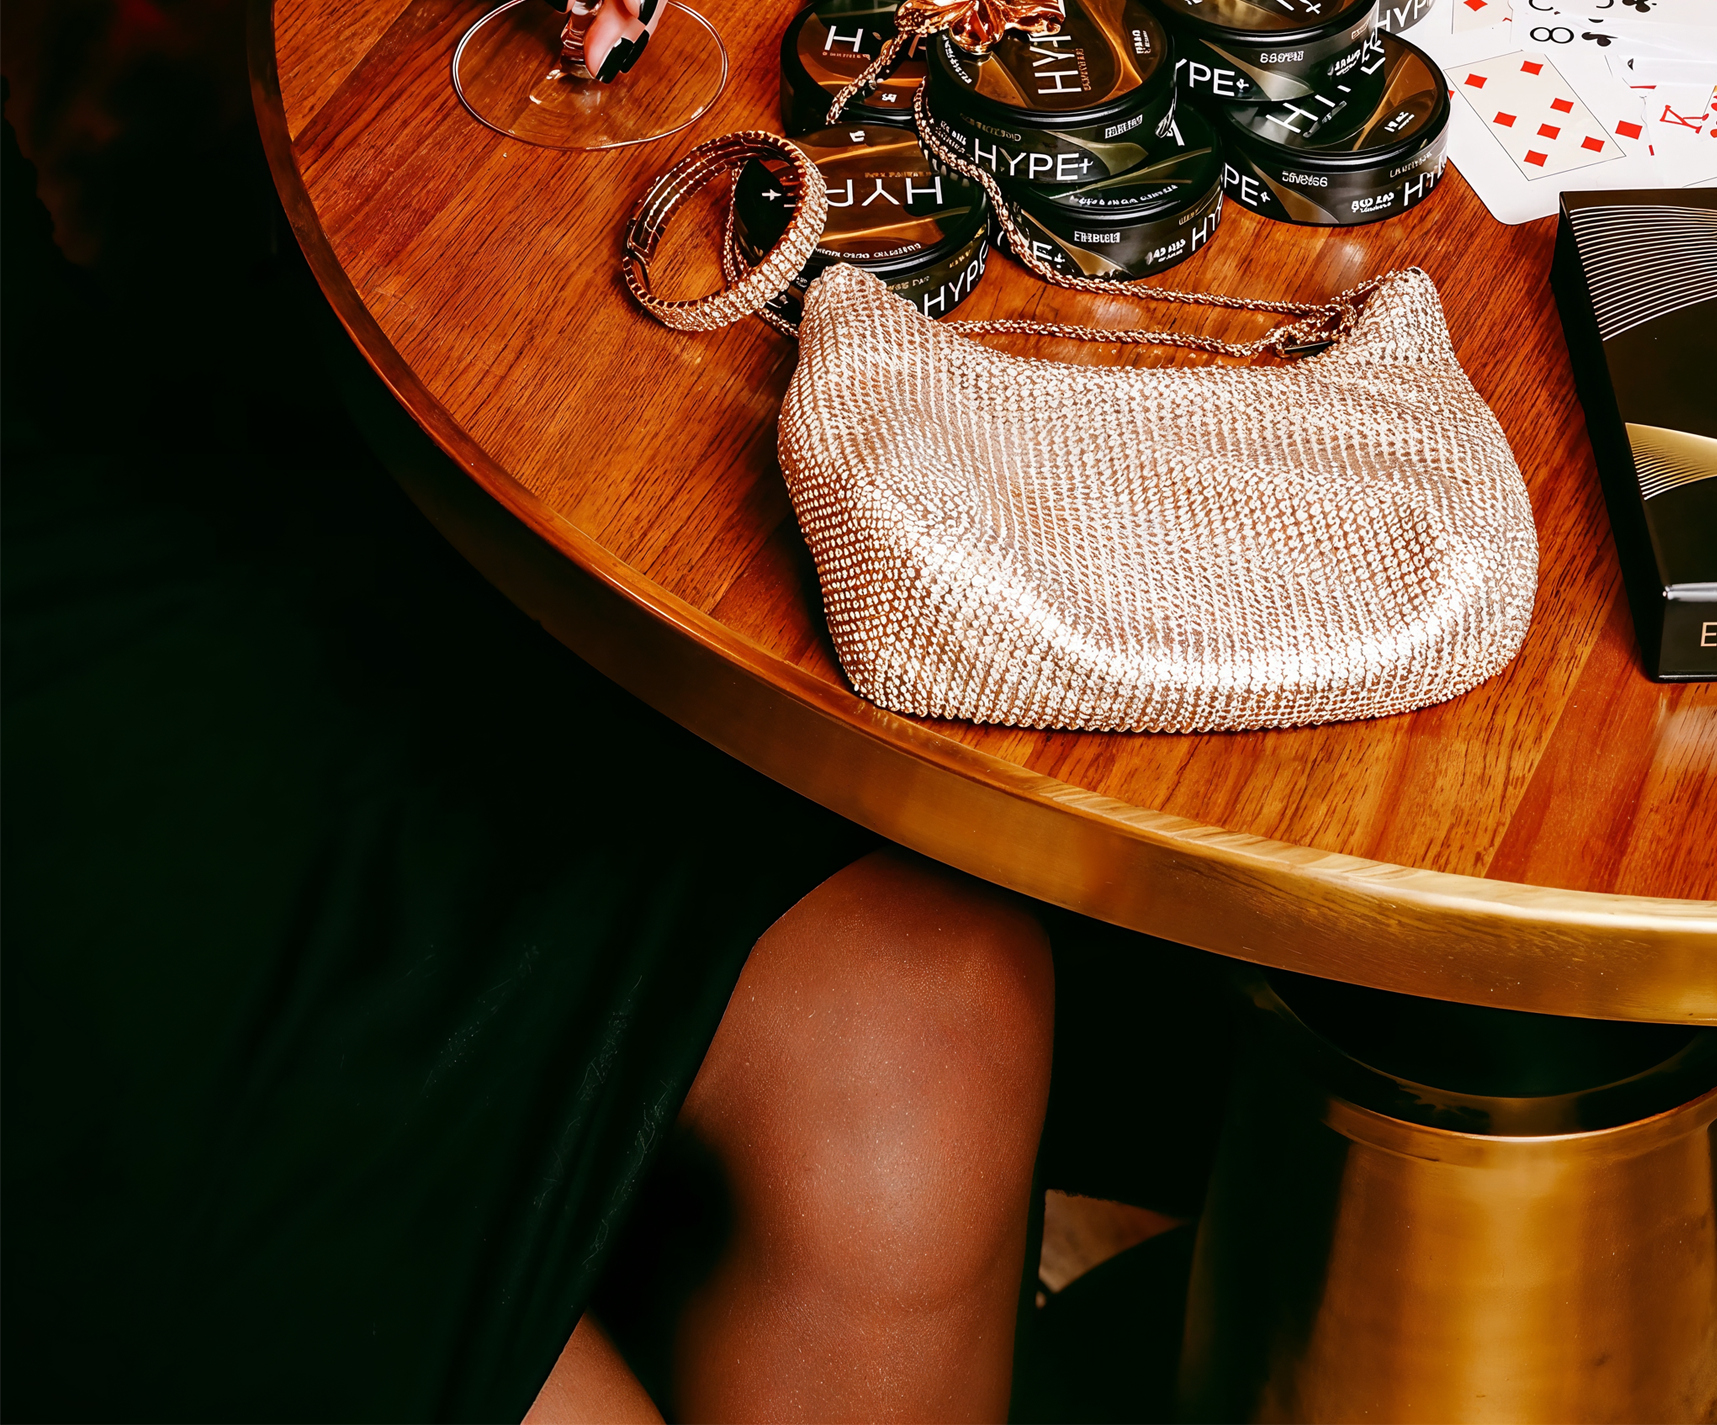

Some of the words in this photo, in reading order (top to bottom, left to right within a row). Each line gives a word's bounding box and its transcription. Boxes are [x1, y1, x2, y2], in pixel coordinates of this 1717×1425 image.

[1528, 26, 1575, 45] 8
[1658, 103, 1710, 135] K
[973, 137, 1094, 182] HYPE+
